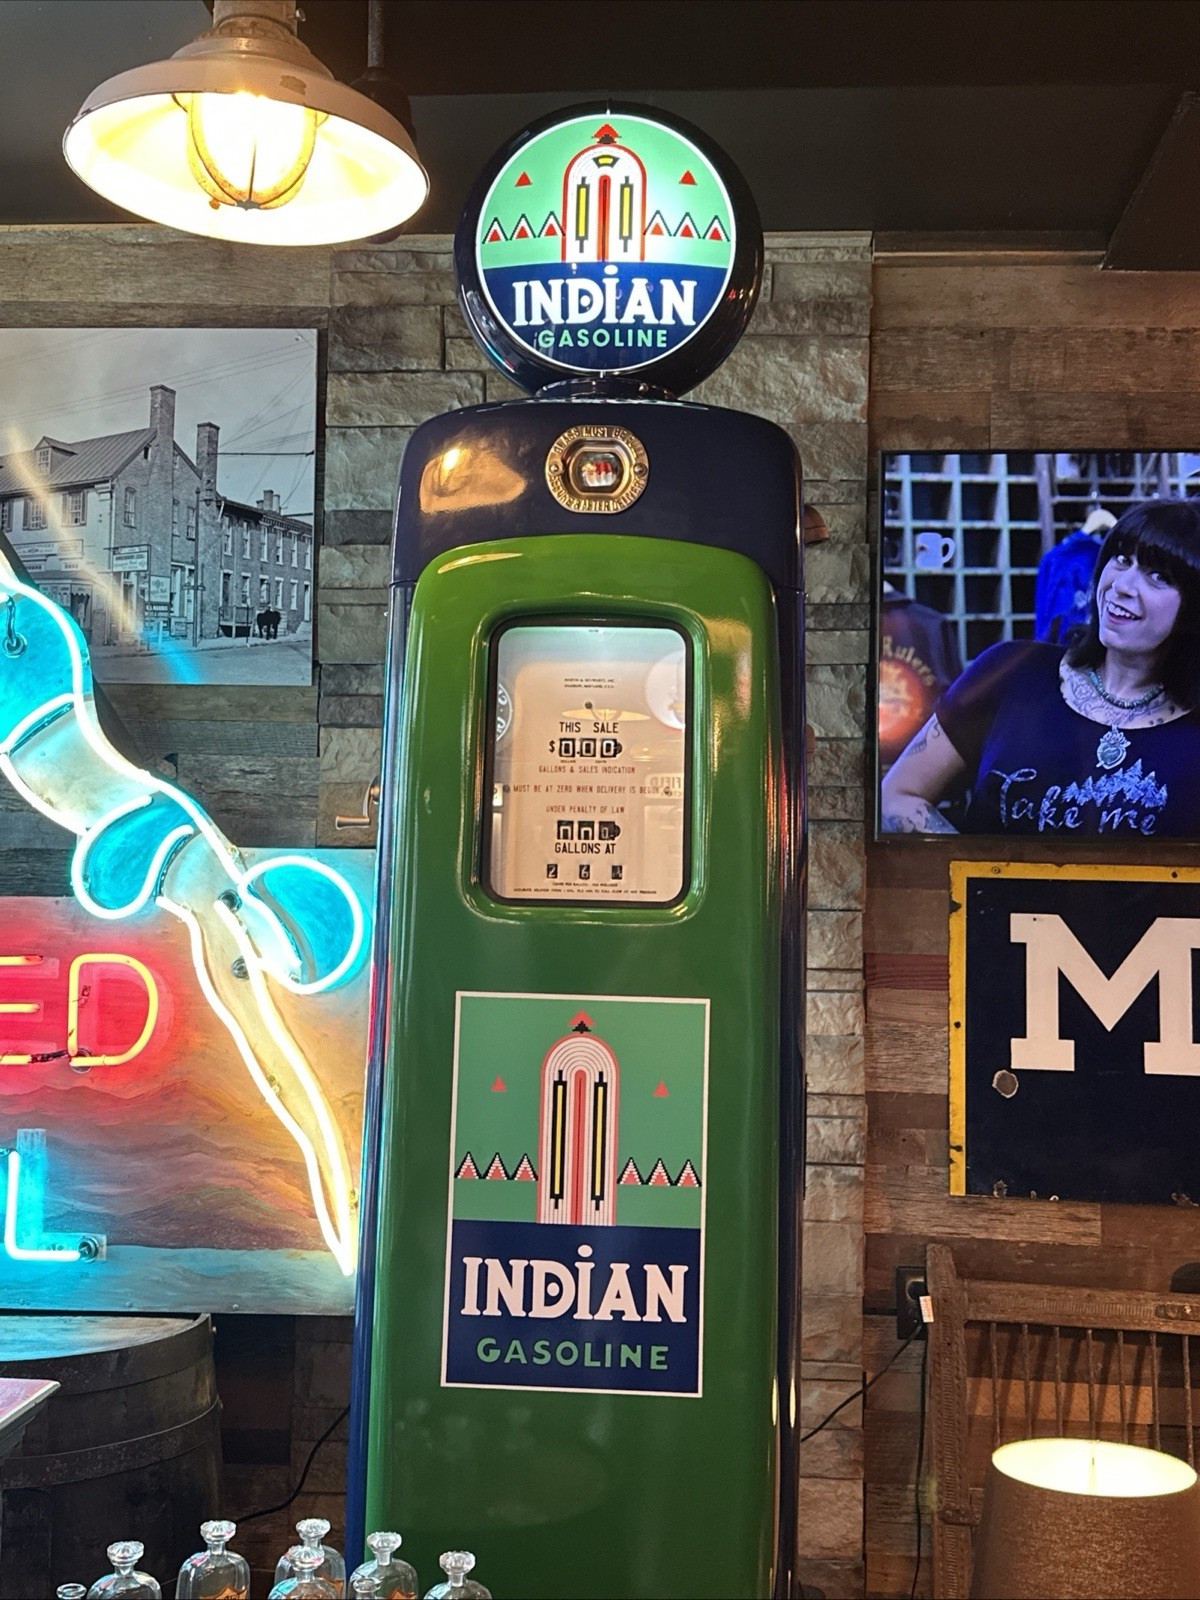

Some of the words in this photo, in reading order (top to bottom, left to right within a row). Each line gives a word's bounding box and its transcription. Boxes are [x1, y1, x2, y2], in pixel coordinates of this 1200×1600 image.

[538, 329, 667, 347] GASOLINE
[559, 721, 581, 733] THIS
[593, 722, 619, 734] SALE
[539, 765, 566, 773] GALLONS
[579, 766, 599, 774] SALES
[602, 766, 636, 775] INDICATION
[513, 784, 530, 792] MUST
[545, 785, 553, 793] AT
[557, 785, 573, 793] ZERO
[576, 785, 593, 793] WHEN
[597, 785, 626, 794] DELIVERY
[629, 786, 636, 794] IS
[987, 768, 1083, 832] Take
[1098, 807, 1157, 836] me
[546, 805, 566, 813] UNDER
[569, 806, 597, 814] PENALTY
[600, 806, 608, 814] OF
[554, 842, 601, 854] GALLONS
[604, 843, 617, 855] AT
[476, 1337, 669, 1370] GASOLINE
